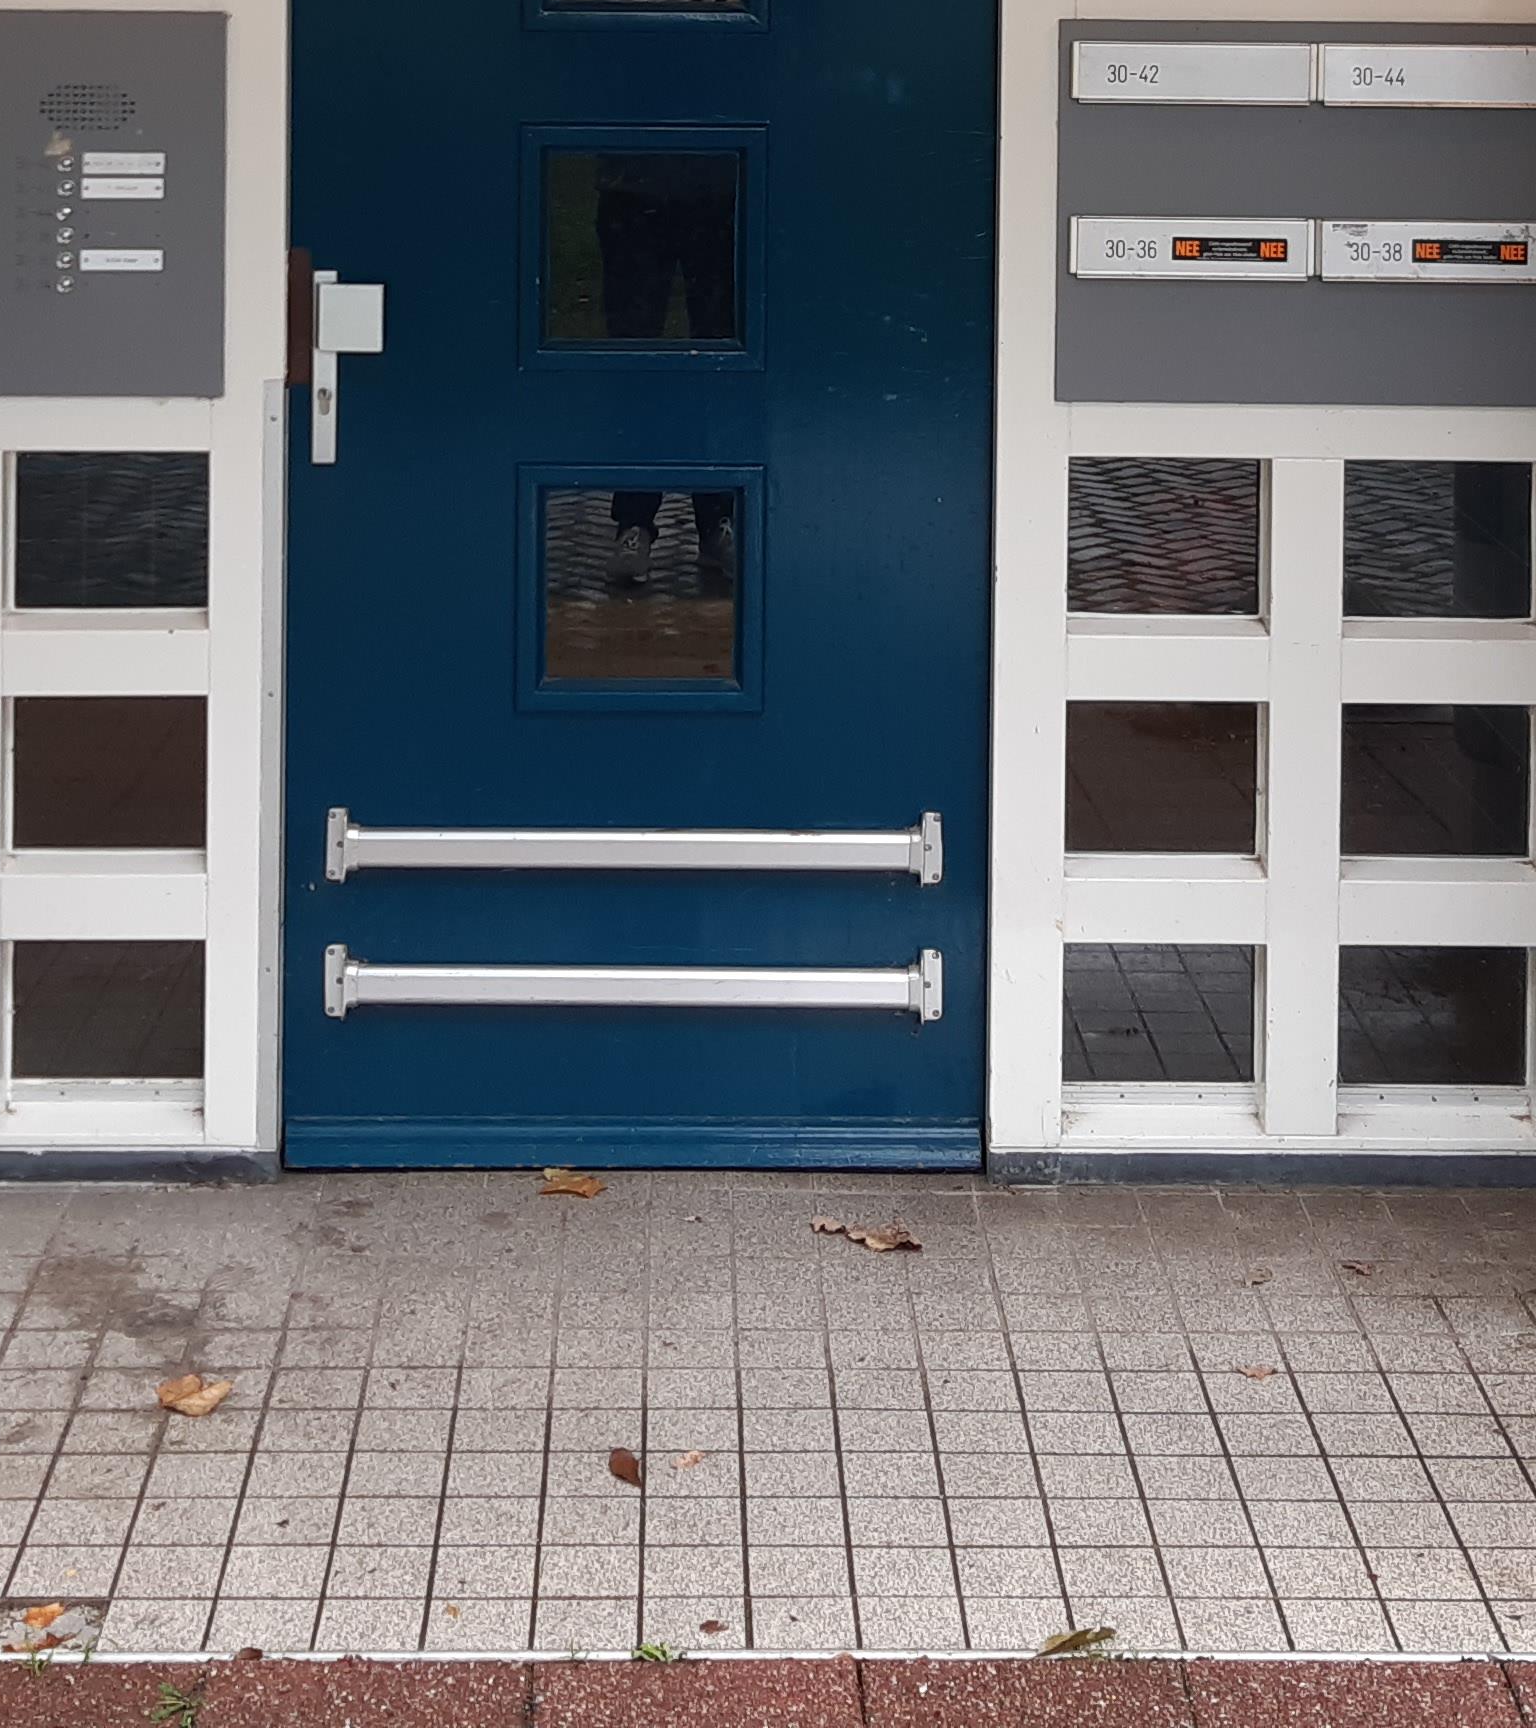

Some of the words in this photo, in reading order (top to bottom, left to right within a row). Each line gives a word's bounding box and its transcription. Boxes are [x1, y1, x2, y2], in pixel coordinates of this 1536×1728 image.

[1107, 64, 1159, 83] 30-42
[1352, 66, 1405, 86] 30-44
[1105, 239, 1157, 259] 30-36
[1175, 239, 1201, 257] NEE
[1259, 241, 1285, 258] NEE
[1350, 242, 1402, 262] 30-38
[1415, 242, 1441, 259] NEE
[1500, 244, 1526, 261] NEE
